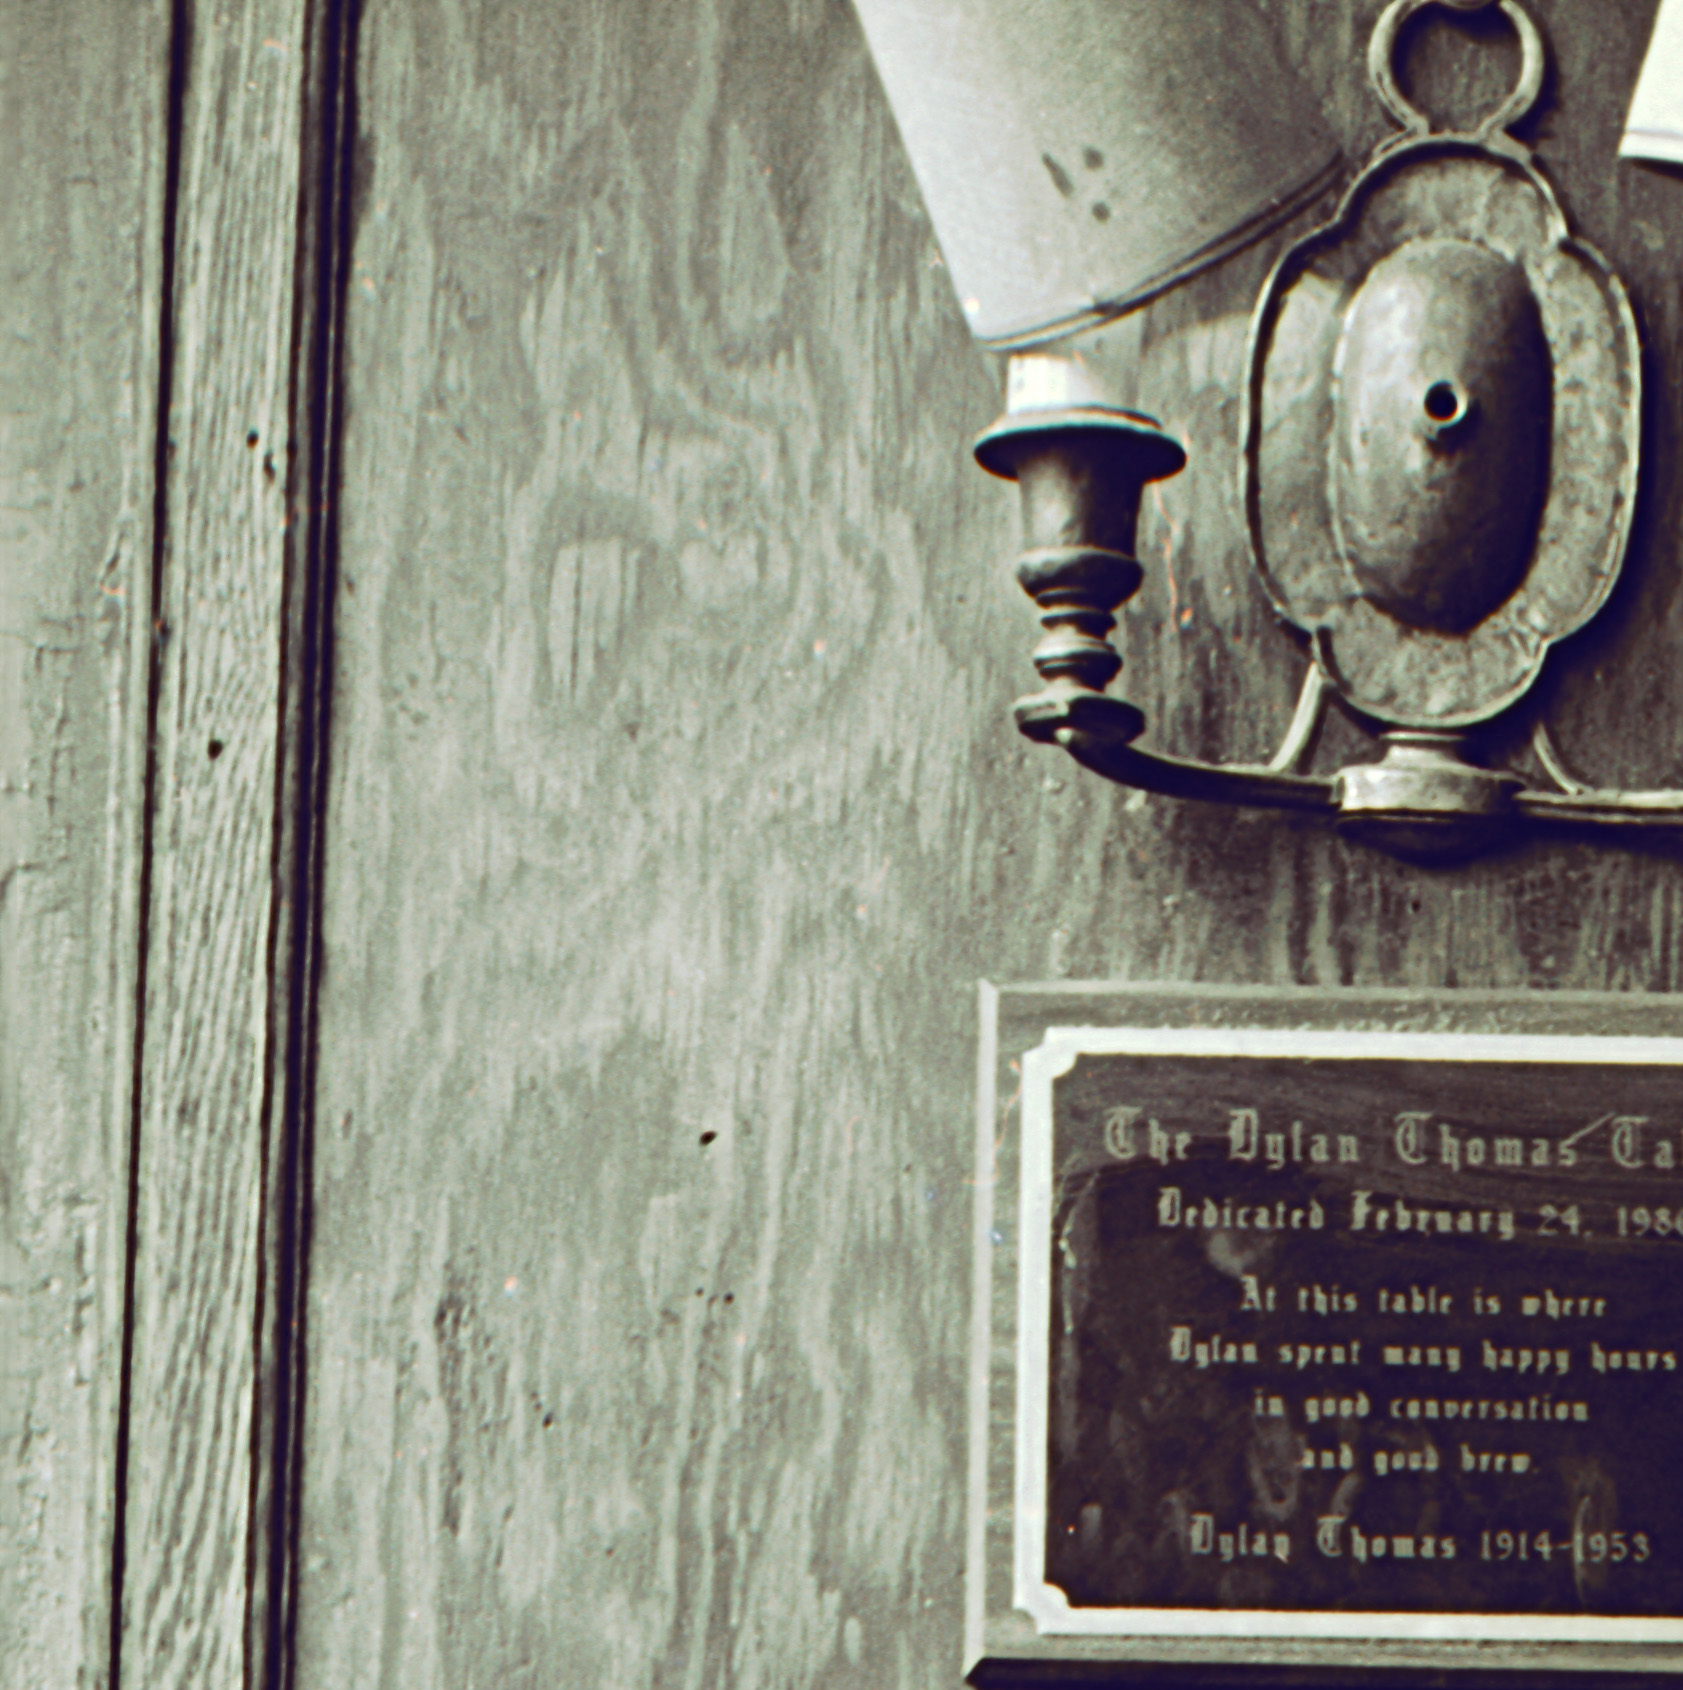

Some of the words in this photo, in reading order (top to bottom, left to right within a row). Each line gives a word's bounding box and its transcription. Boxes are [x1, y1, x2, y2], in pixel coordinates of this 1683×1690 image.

[1102, 1105, 1193, 1165] The
[1228, 1108, 1360, 1171] Dylan
[1394, 1111, 1578, 1171] Thomas
[1158, 1187, 1324, 1229] Dedicated
[1350, 1190, 1515, 1241] February
[1239, 1274, 1276, 1313] At
[1297, 1283, 1358, 1316] this
[1379, 1285, 1452, 1314] table
[1473, 1287, 1500, 1315] is
[1521, 1288, 1607, 1320] where
[1169, 1325, 1257, 1369] Dylan
[1278, 1340, 1360, 1370] spent
[1384, 1346, 1461, 1373] many
[1482, 1339, 1570, 1375] happy
[1591, 1341, 1677, 1374] hours
[1255, 1387, 1284, 1417] in
[1305, 1390, 1370, 1423] good
[1391, 1394, 1589, 1422] conversation
[1300, 1442, 1354, 1470] and
[1374, 1444, 1440, 1476] good
[1190, 1512, 1291, 1563] Dylan
[1316, 1515, 1456, 1563] Thomas
[1481, 1530, 1651, 1563] 1914-1953
